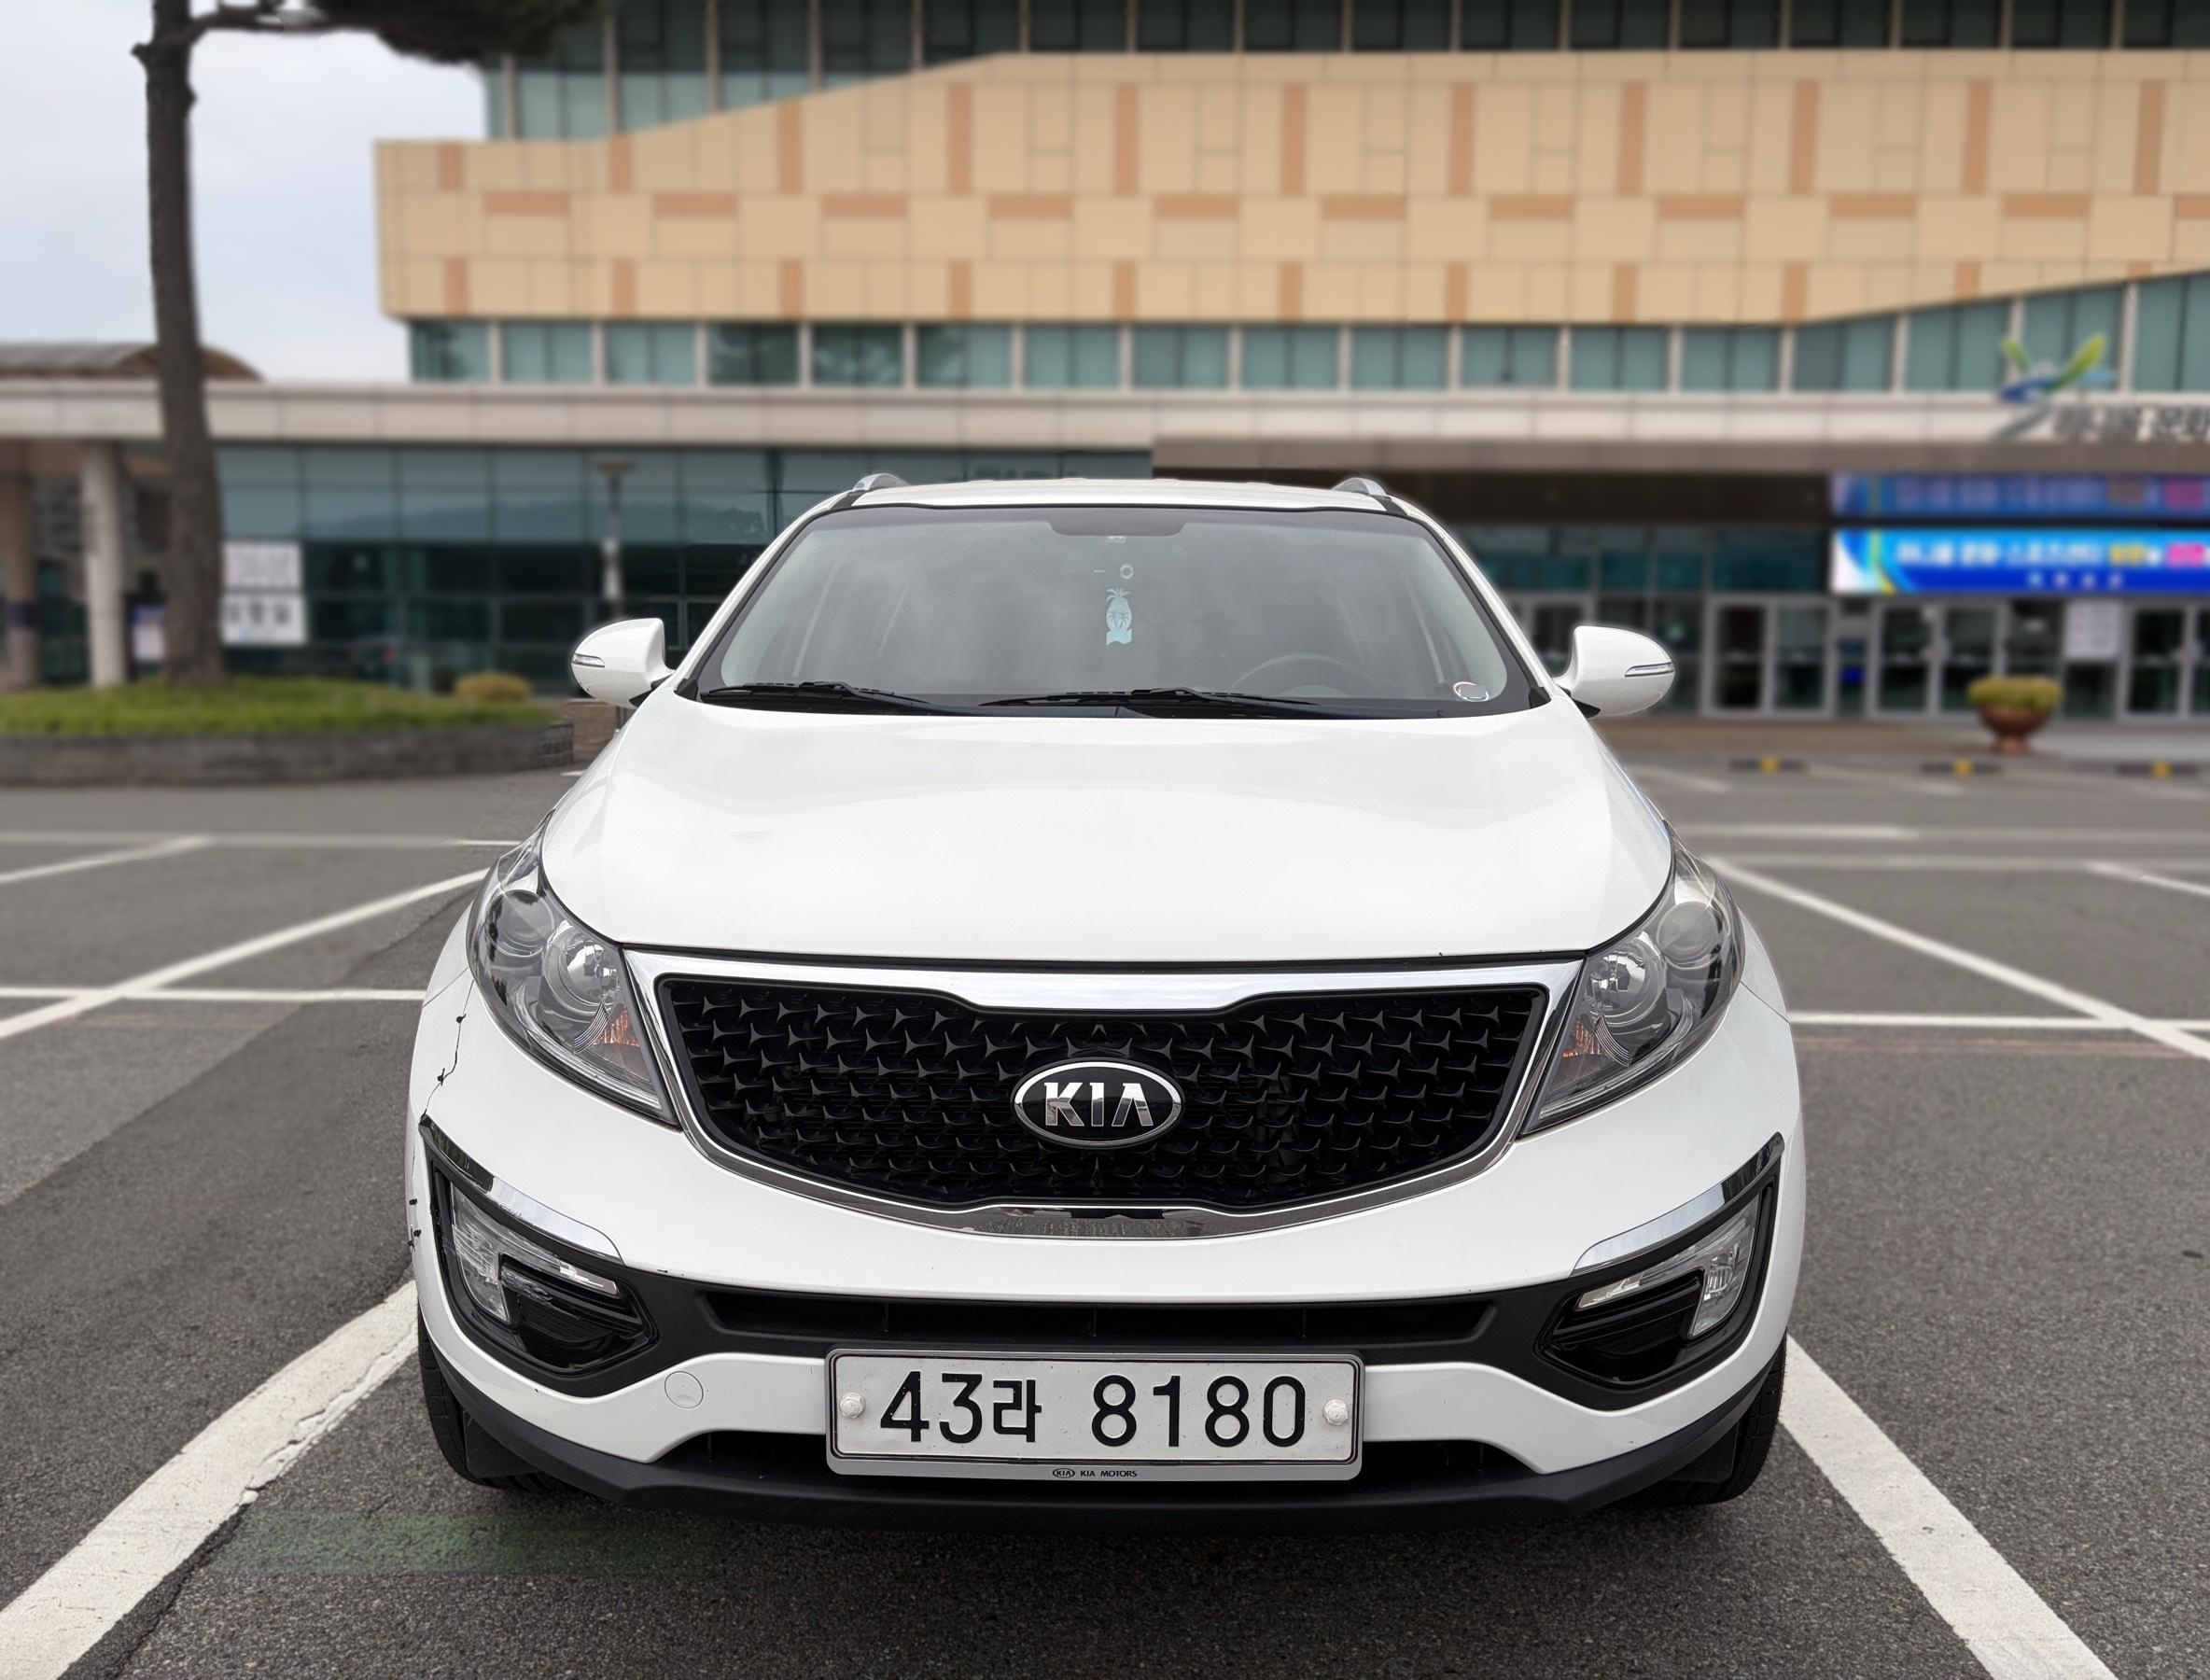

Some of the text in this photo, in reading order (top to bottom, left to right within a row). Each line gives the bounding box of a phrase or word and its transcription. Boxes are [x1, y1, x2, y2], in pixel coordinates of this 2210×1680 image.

[1043, 1082, 1154, 1127] KIA
[879, 1369, 1306, 1448] 43라 8180
